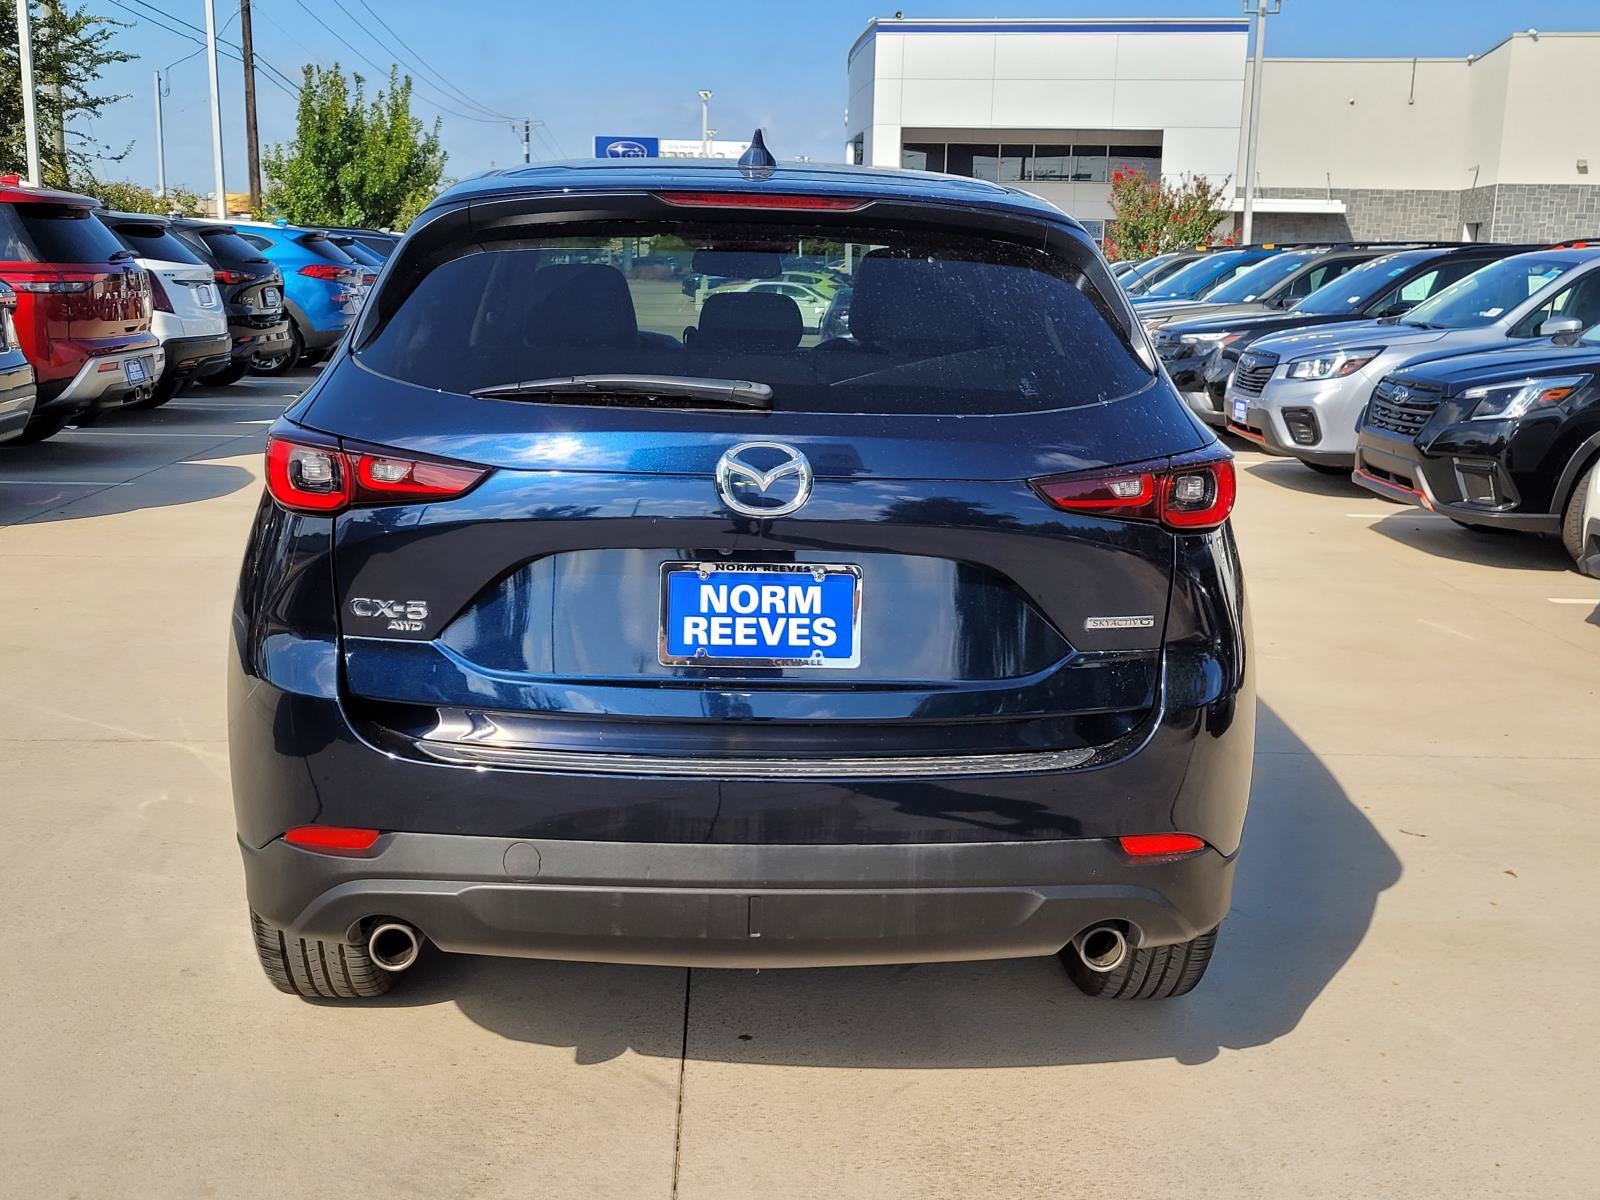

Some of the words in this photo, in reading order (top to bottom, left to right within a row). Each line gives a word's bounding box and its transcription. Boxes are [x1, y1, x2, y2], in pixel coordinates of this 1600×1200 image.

[714, 563, 758, 572] NORM
[763, 565, 811, 573] REEVES
[351, 597, 429, 620] CX-5
[700, 585, 821, 614] NORM
[387, 620, 424, 631] AWD
[683, 616, 837, 646] REEVES
